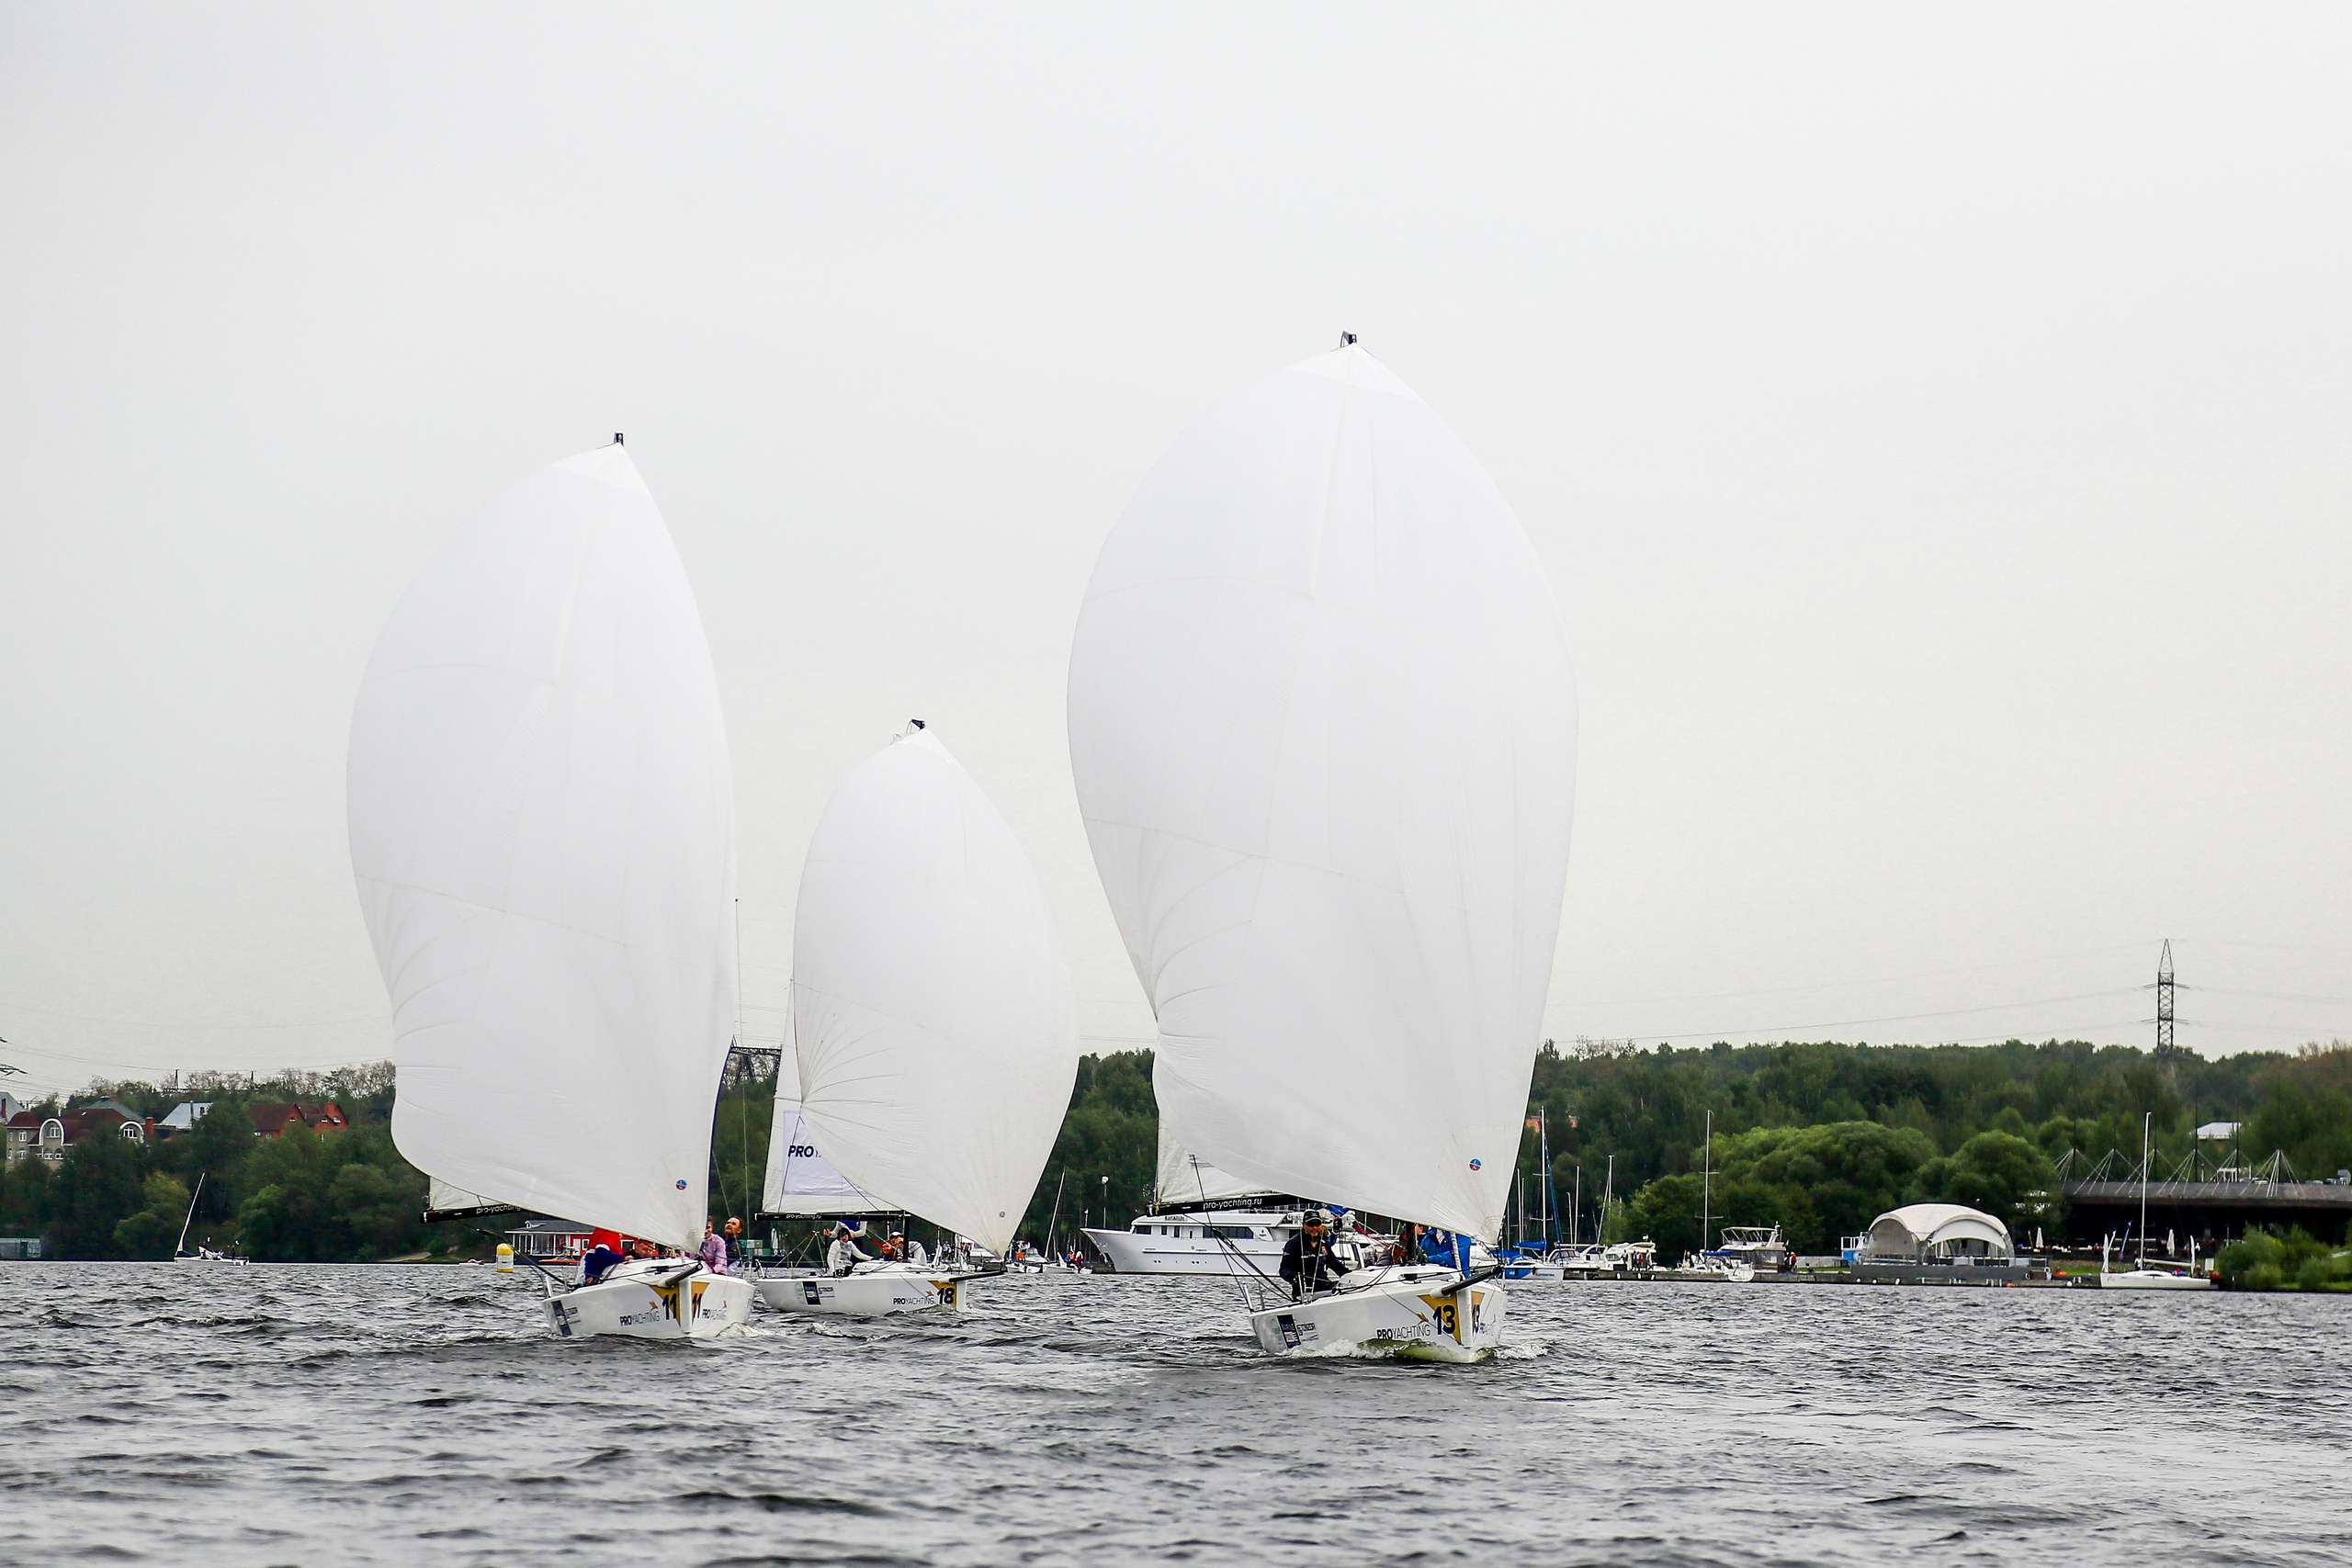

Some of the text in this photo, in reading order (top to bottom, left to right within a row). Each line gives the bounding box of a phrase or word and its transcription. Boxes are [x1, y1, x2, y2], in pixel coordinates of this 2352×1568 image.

[1204, 1198, 1262, 1211] pro-yachting.ru
[662, 1292, 677, 1320] 11
[692, 1292, 703, 1319] 11
[937, 1287, 956, 1305] 18
[619, 1310, 660, 1327] PROYACHTING
[1432, 1304, 1456, 1335] 13
[1472, 1304, 1480, 1334] 13
[1376, 1324, 1430, 1340] PROYACHTING
